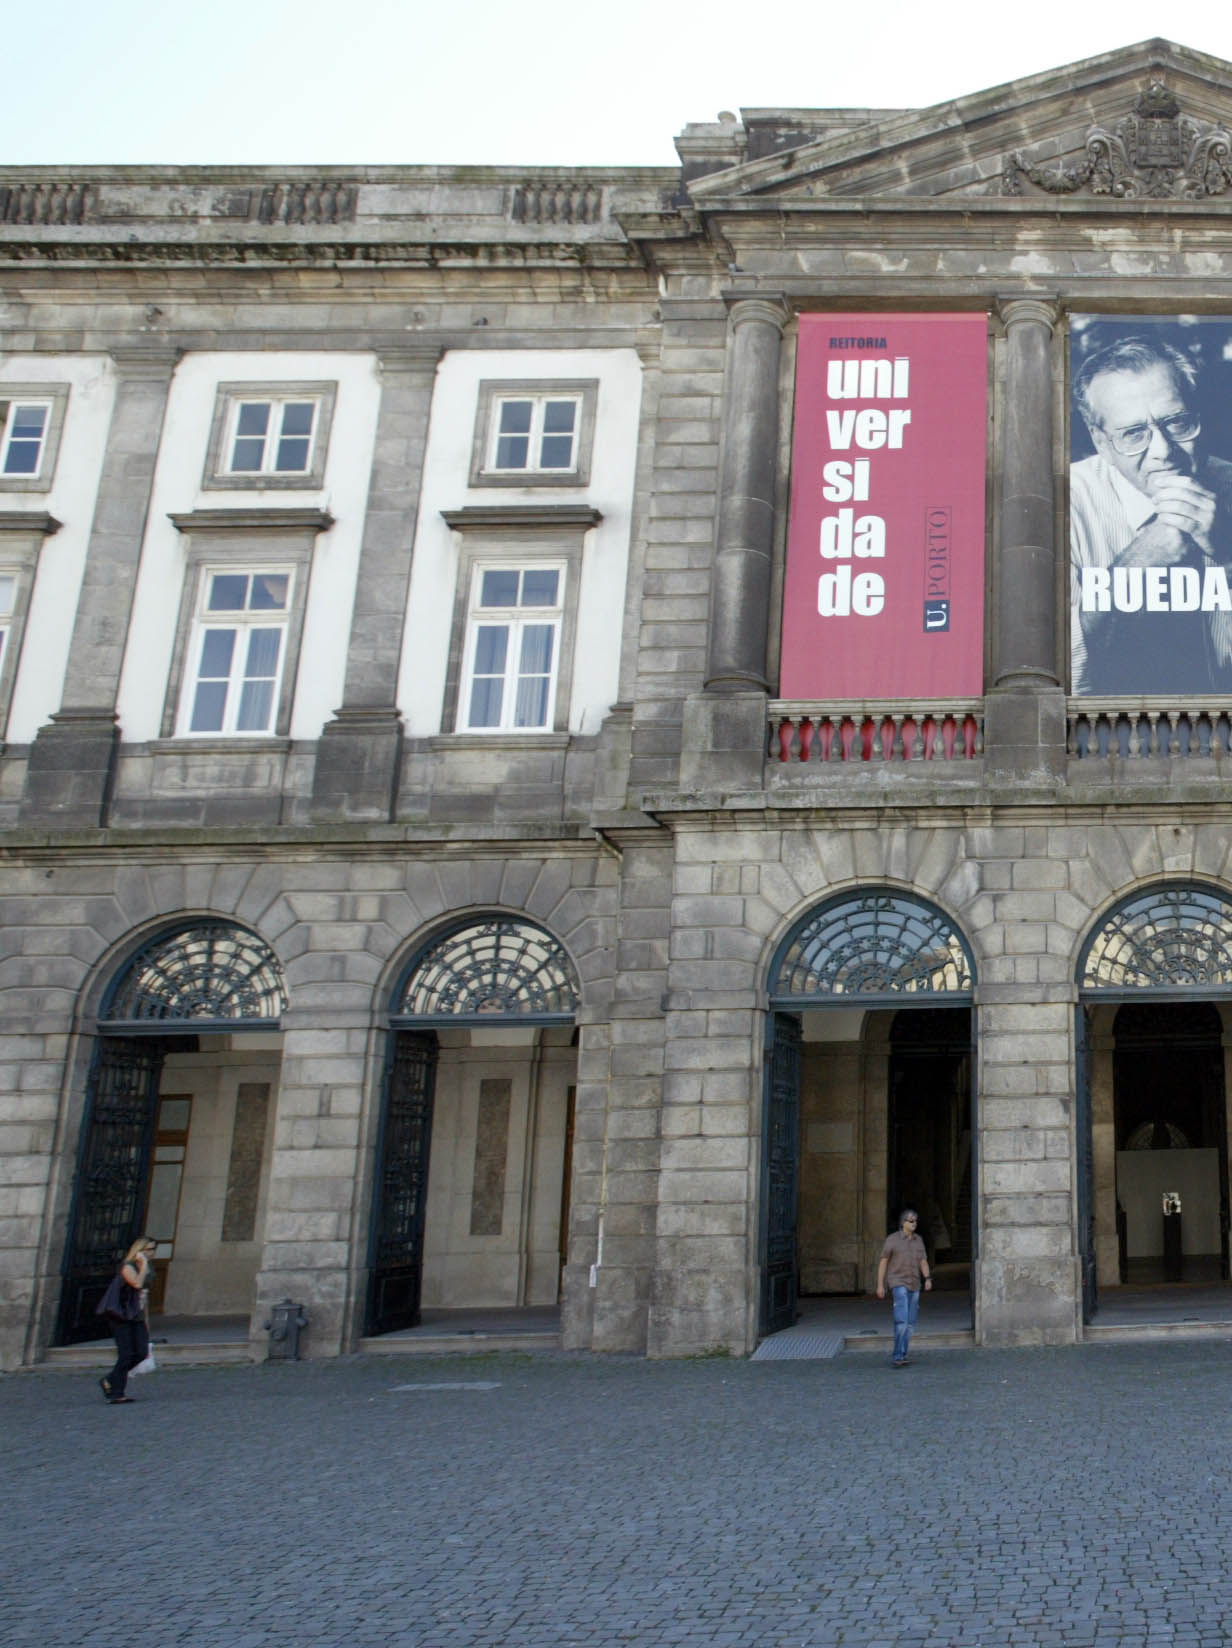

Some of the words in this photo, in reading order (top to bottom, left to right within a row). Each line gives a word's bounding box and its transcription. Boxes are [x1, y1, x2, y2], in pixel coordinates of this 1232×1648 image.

[829, 337, 886, 349] REITORIA
[827, 357, 909, 399] uni
[826, 409, 911, 449] ver
[822, 458, 869, 502] si
[820, 508, 886, 559] da
[928, 510, 948, 596] PORTO
[817, 565, 885, 617] de
[1081, 567, 1232, 612] RUEDA
